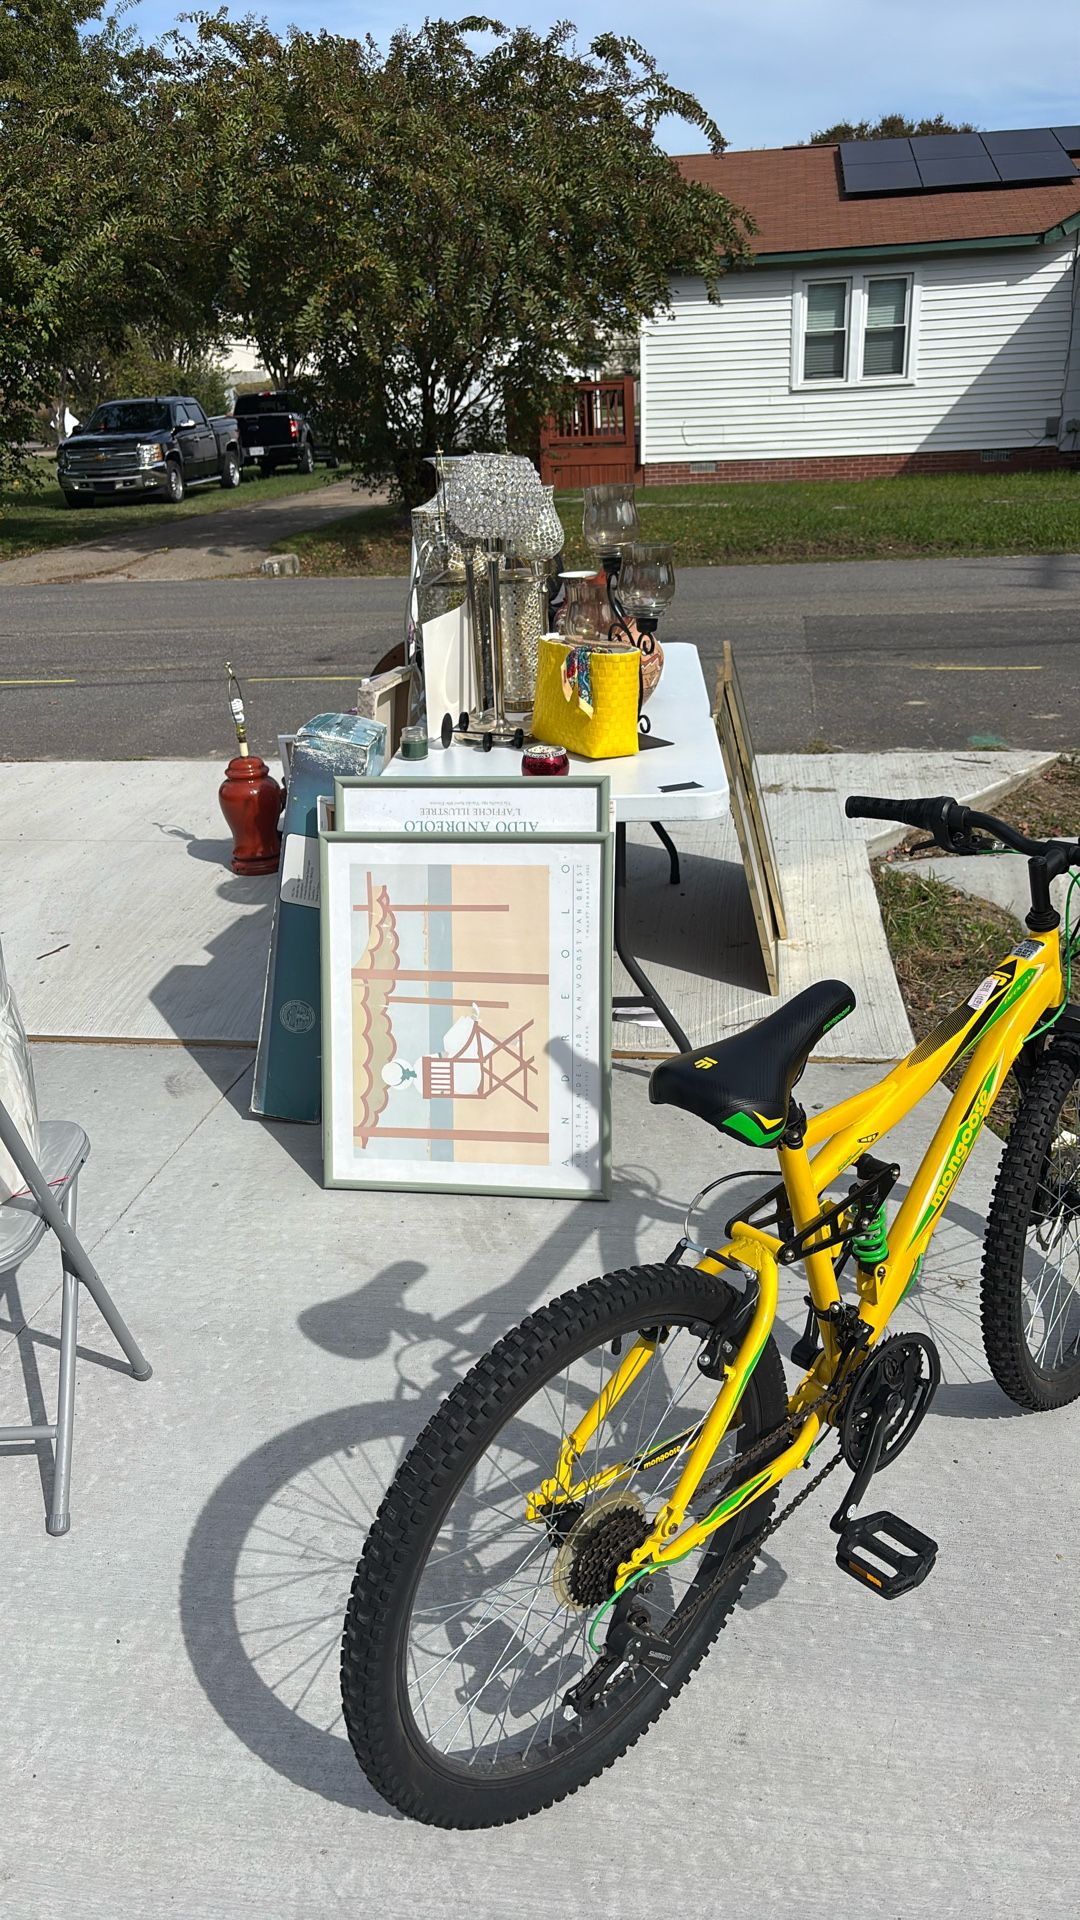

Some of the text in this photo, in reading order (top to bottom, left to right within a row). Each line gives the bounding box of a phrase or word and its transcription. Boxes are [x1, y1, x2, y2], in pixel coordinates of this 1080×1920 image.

[473, 807, 521, 817] L'AFFICHE
[404, 820, 539, 832] ALDO ANDREOLO
[561, 865, 570, 1167] ANDREOLO
[931, 1089, 990, 1208] mongoose
[643, 1445, 681, 1470] mongoose
